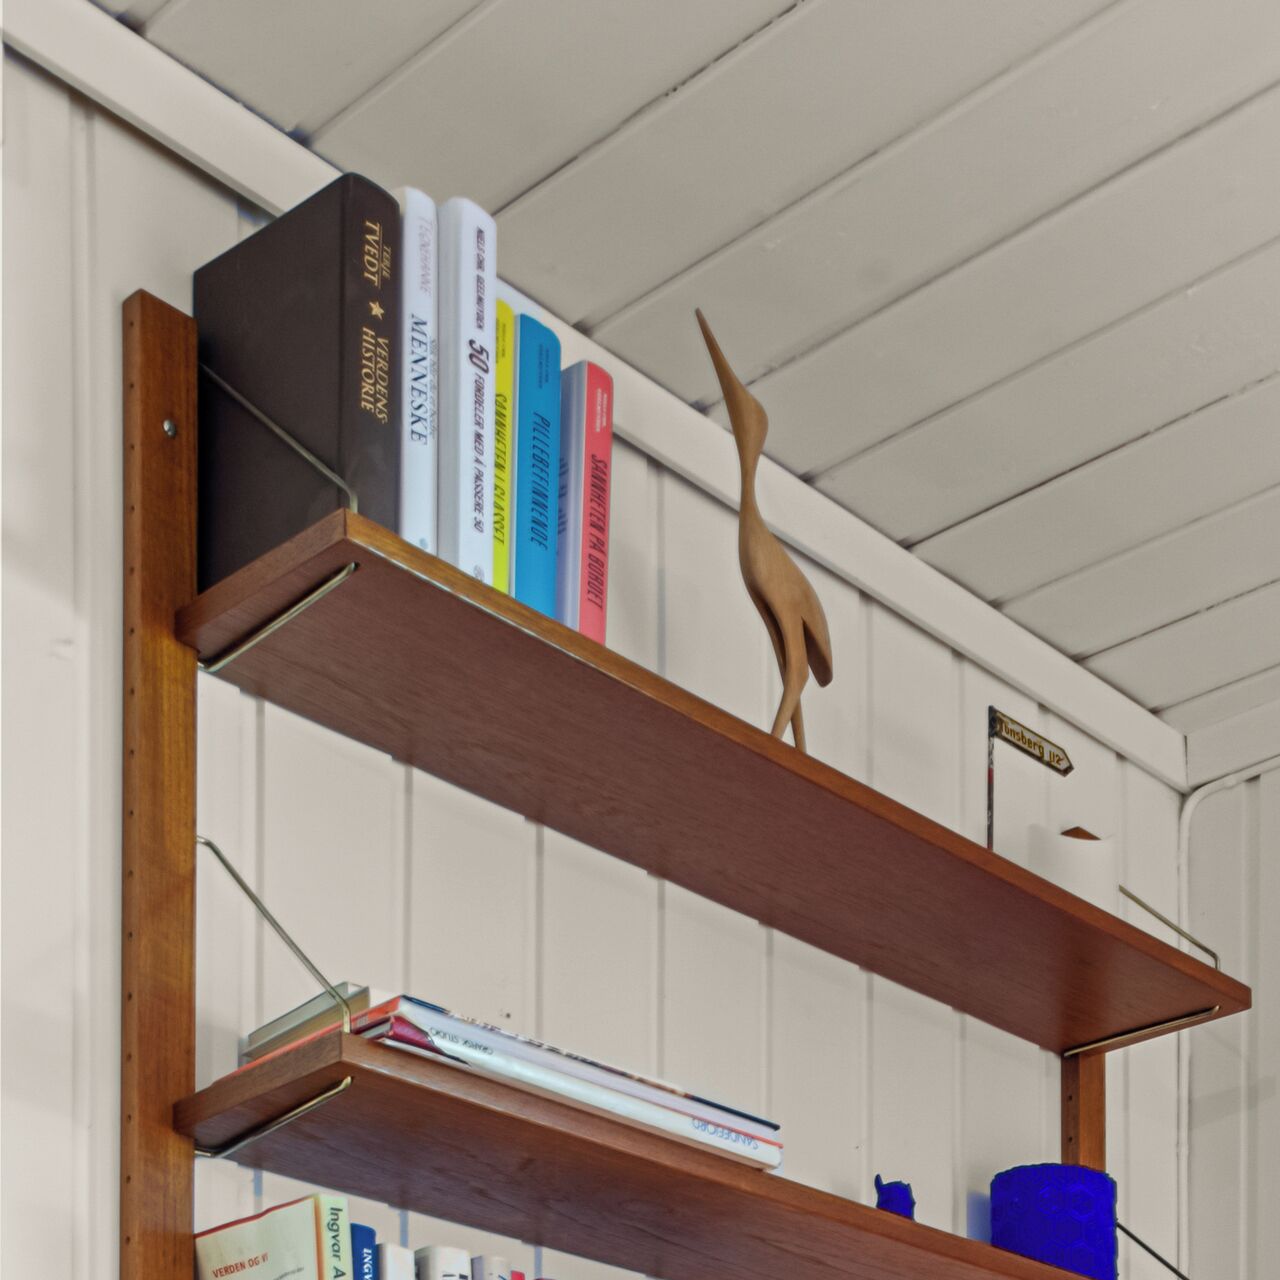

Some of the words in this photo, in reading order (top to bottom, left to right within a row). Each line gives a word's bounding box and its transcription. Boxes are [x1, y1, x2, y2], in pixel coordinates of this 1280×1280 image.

[364, 220, 381, 287] TVEDT
[382, 245, 391, 279] TERJE
[361, 326, 376, 413] HISTORIE
[410, 313, 429, 446] MENNESKE
[469, 339, 489, 374] 50
[474, 373, 485, 430] FORDELER
[474, 430, 485, 454] MED
[474, 467, 485, 517] PASSERE
[531, 411, 551, 551] PILLEBEFINNENDE
[590, 454, 608, 534] SANNHETEN
[474, 517, 485, 533] 50
[590, 532, 607, 557] PÅ
[587, 553, 605, 609] BORDET
[327, 1207, 343, 1261] Ingvar
[212, 1262, 247, 1278] VERDEN
[247, 1256, 260, 1268] OG
